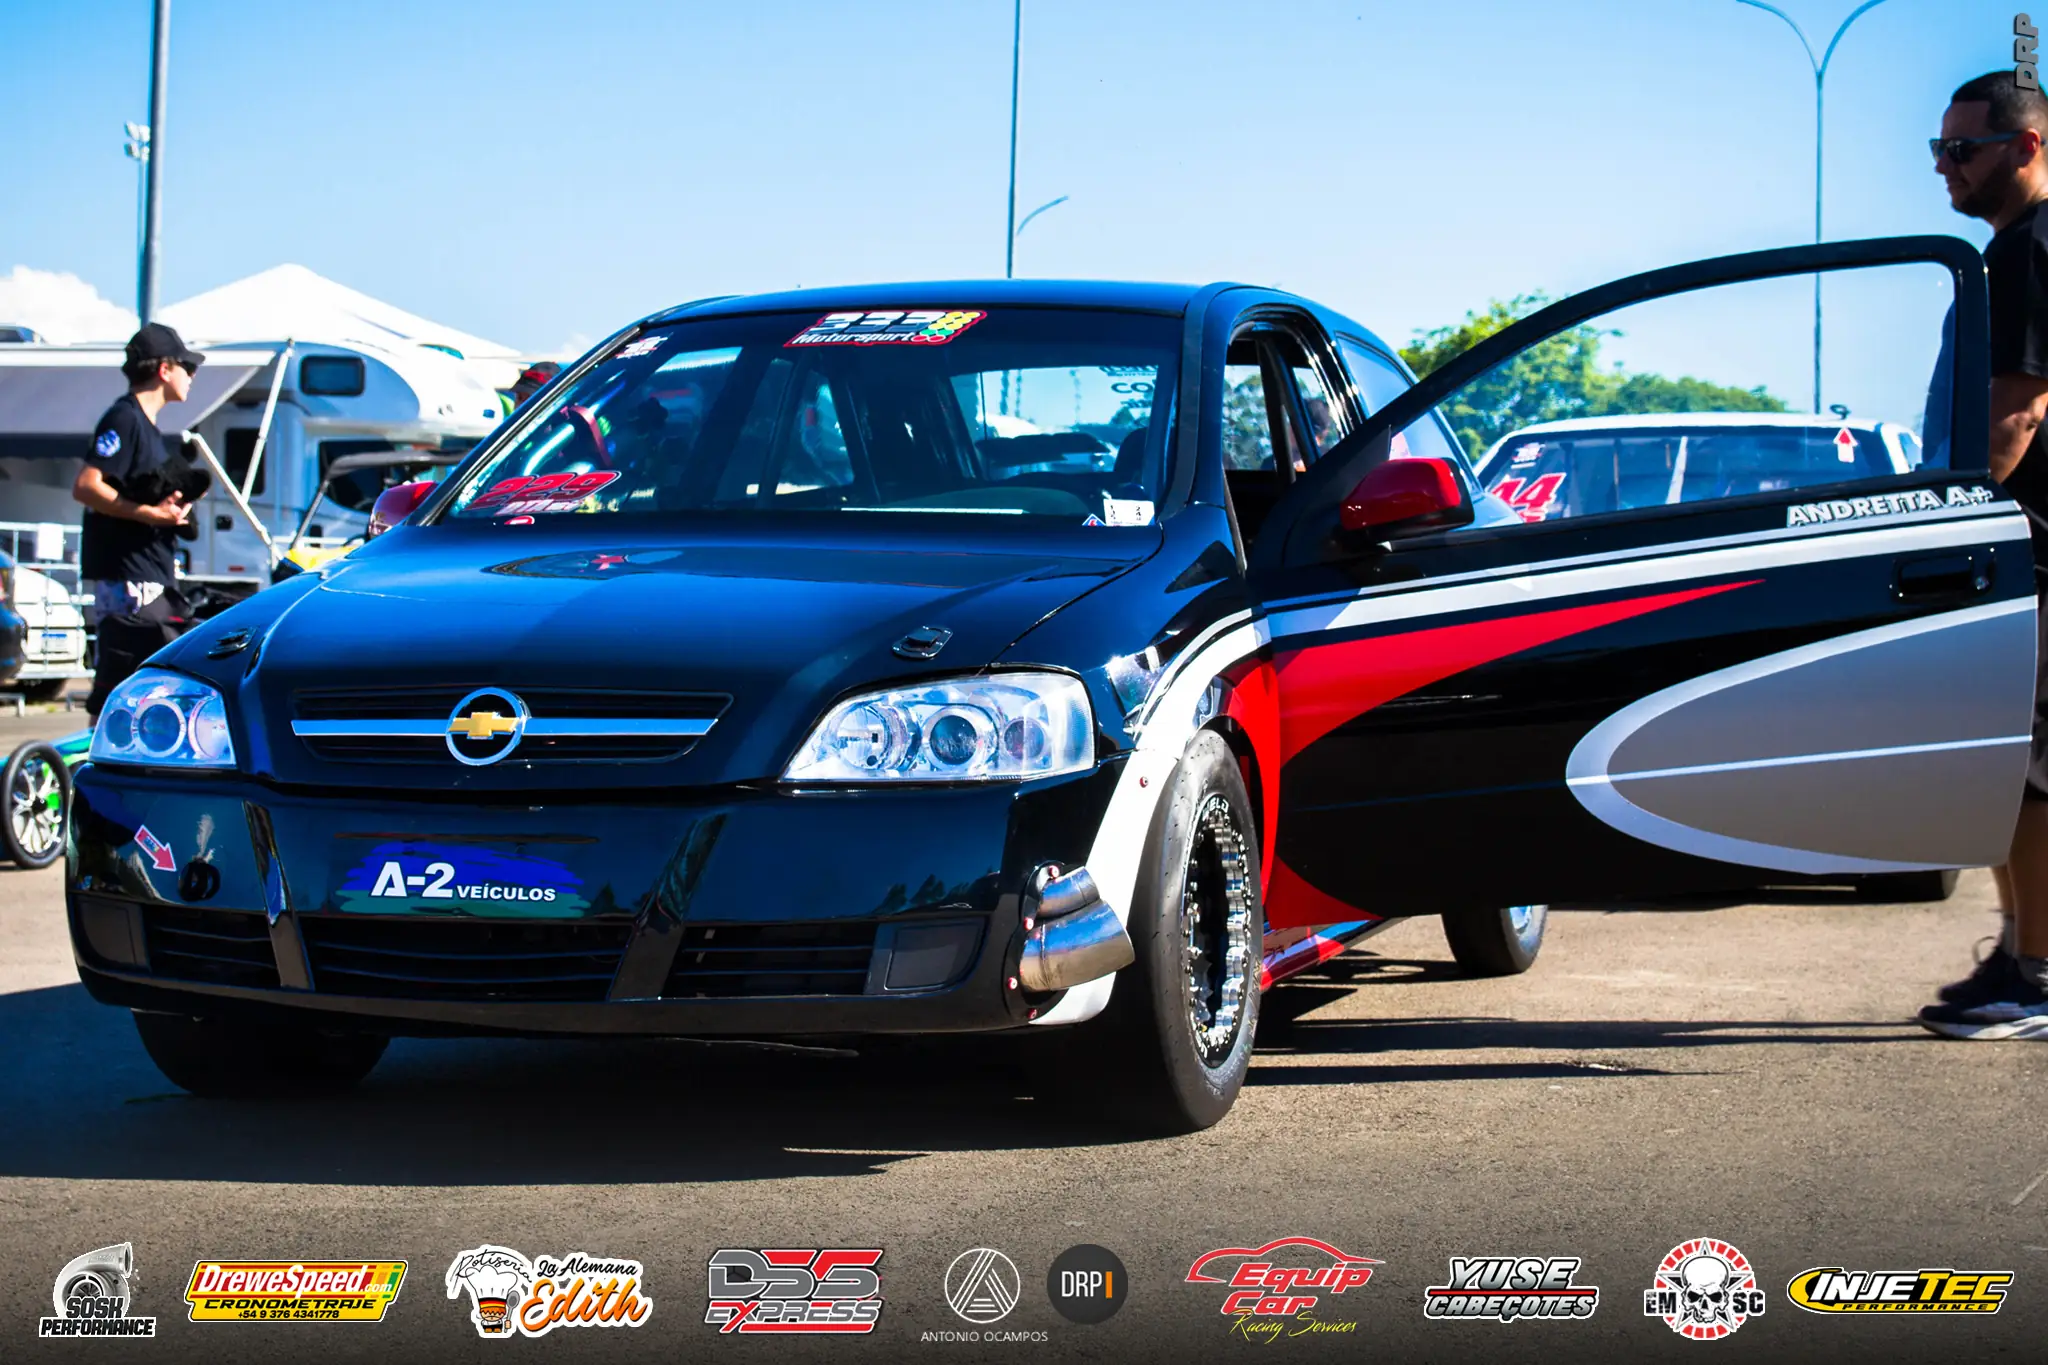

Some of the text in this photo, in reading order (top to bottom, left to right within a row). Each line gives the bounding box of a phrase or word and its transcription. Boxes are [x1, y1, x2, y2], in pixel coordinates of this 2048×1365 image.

[792, 331, 915, 345] Motorsport
[806, 311, 945, 334] 333
[1787, 489, 1944, 528] ANDRETTA
[370, 861, 556, 902] A-2 VEÍCULOS
